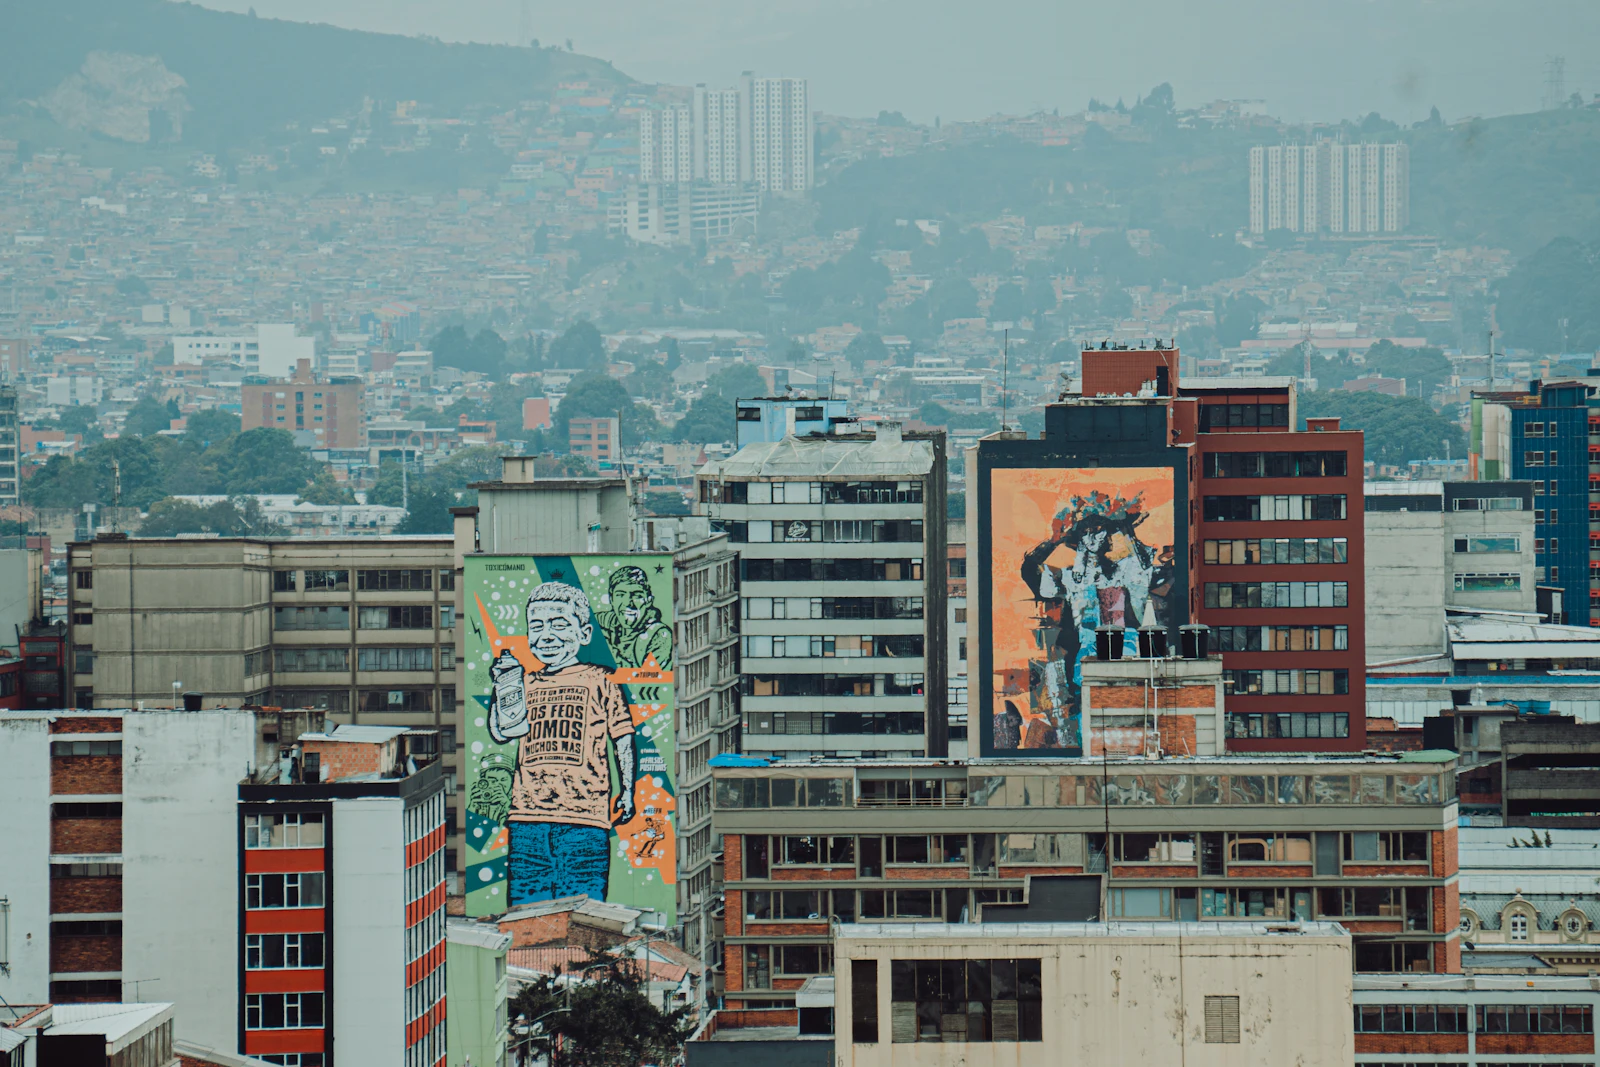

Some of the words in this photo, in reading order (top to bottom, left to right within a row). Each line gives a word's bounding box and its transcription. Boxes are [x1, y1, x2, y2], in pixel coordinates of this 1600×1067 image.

[559, 687, 586, 695] MENSAJE
[530, 705, 547, 721] OS
[551, 704, 584, 720] FEOS
[525, 740, 558, 756] MUCHOS
[561, 740, 581, 754] MAS
